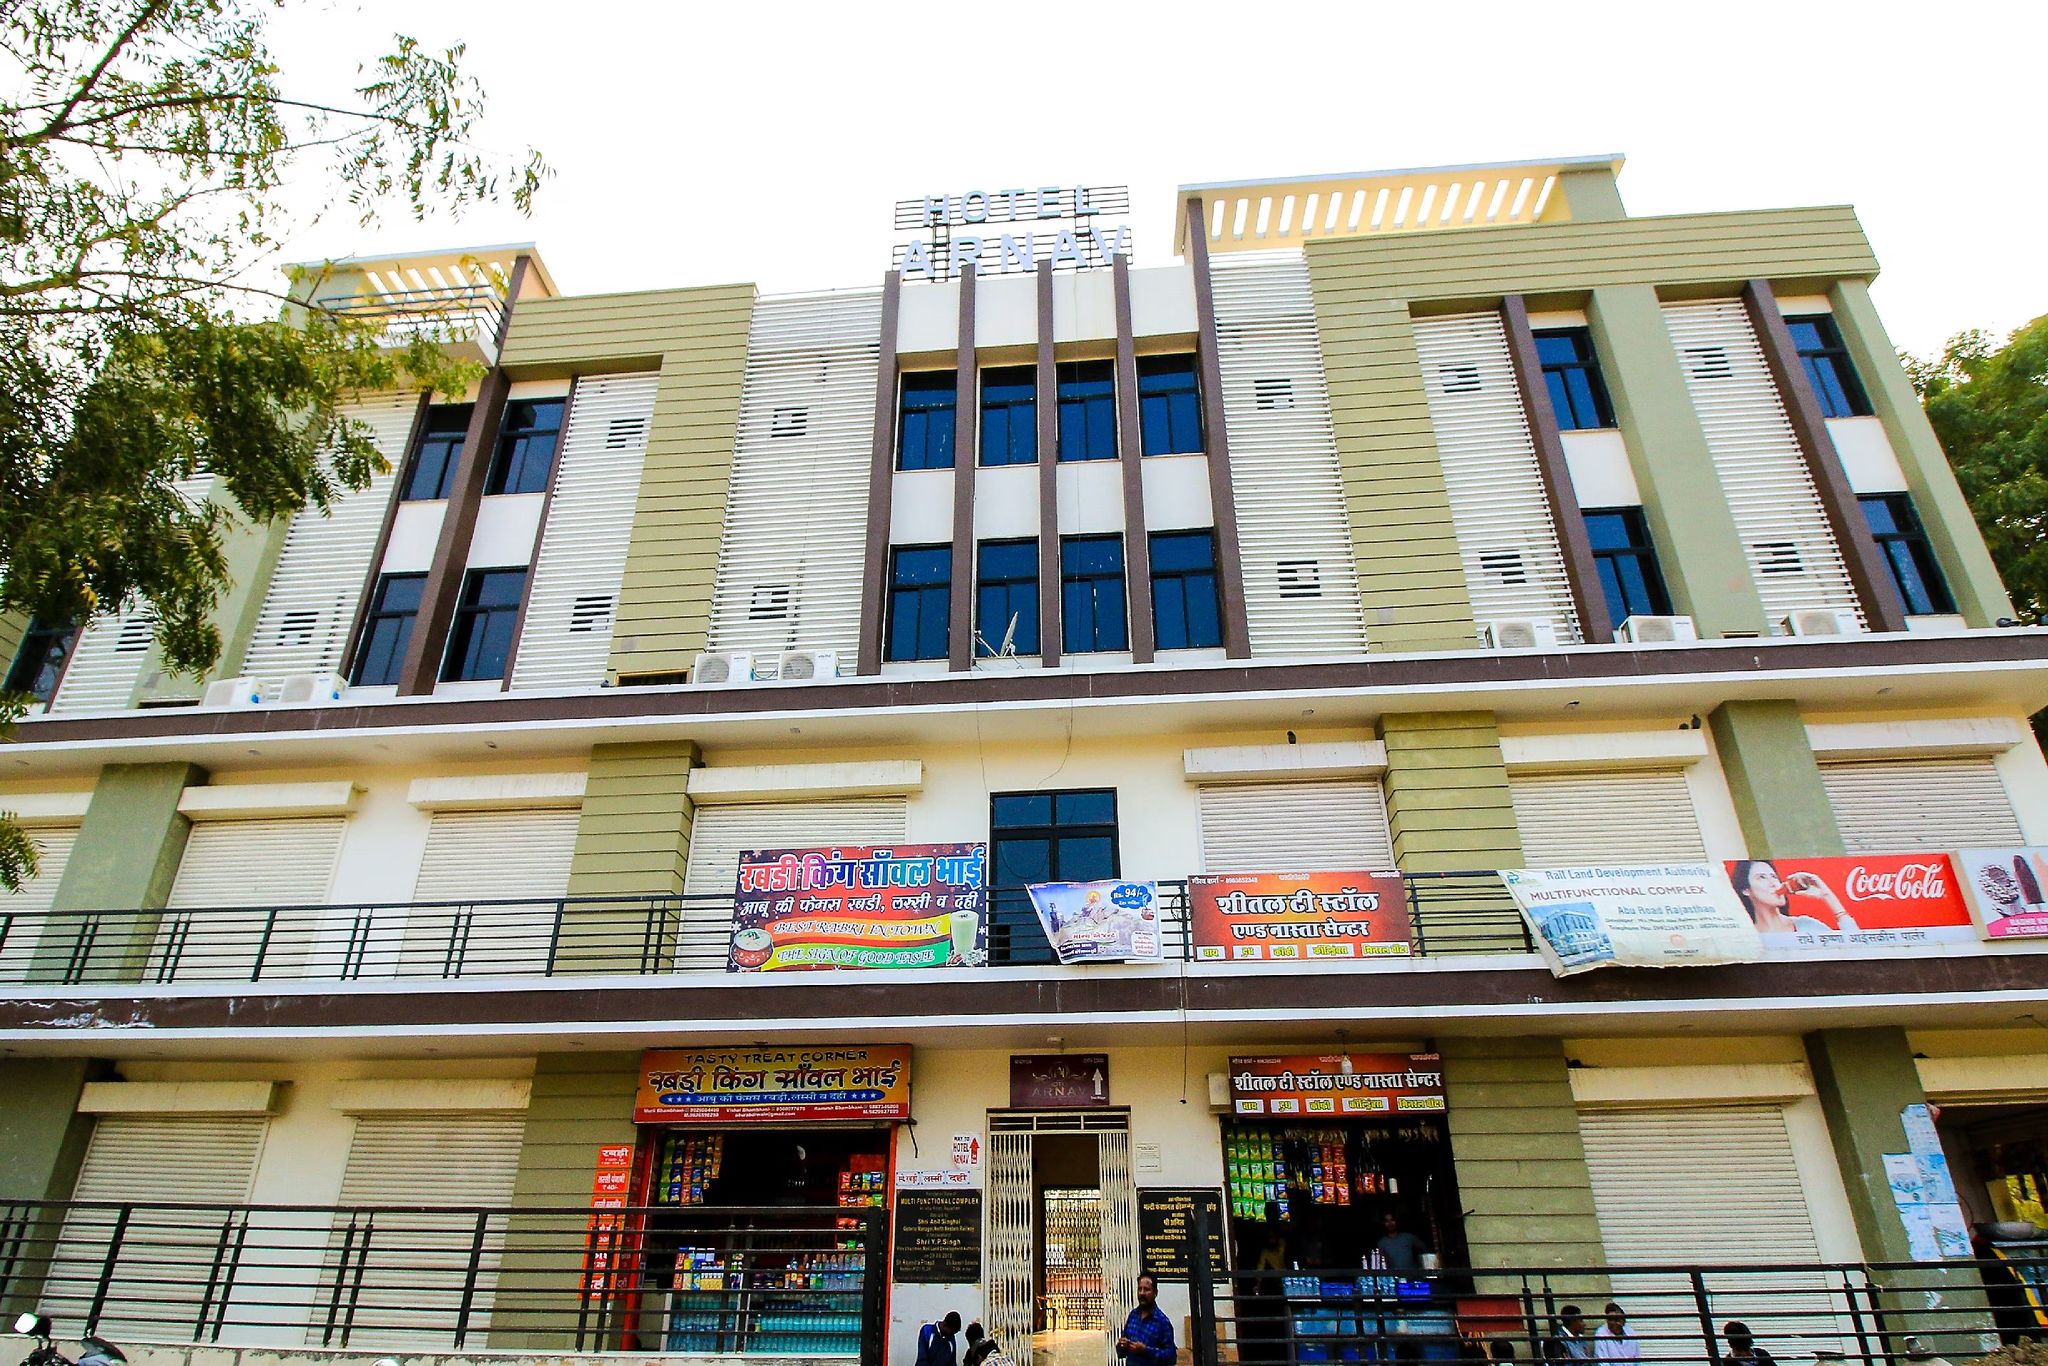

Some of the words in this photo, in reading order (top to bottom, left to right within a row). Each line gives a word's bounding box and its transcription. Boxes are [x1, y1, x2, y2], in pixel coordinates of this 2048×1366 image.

[922, 185, 1100, 227] HOTEL
[899, 225, 1127, 278] ARNAV
[801, 850, 858, 891] किंग
[936, 847, 985, 890] भाई
[1545, 870, 1566, 880] Rail
[1569, 869, 1593, 879] Land
[1597, 867, 1662, 879] Development
[1665, 866, 1711, 878] Authority
[1529, 886, 1645, 901] MULTIFUNCTIONAL
[1648, 885, 1707, 896] COMPLEX
[1845, 863, 1947, 902] Coca-Cola
[775, 896, 795, 913] की
[1216, 890, 1286, 915] शीतल
[1288, 889, 1317, 914] टी
[1319, 887, 1379, 913] स्टॉल
[774, 920, 816, 935] BEST
[817, 920, 864, 937] RABRI
[685, 1053, 738, 1064] TASTY
[743, 1051, 796, 1064] TREAT
[800, 1049, 869, 1063] CORNER
[712, 1065, 769, 1091] किंग
[852, 1060, 900, 1088] भाई
[1233, 1072, 1277, 1091] शीतल
[1278, 1071, 1295, 1090] टी
[1296, 1069, 1333, 1090] स्टॉल
[953, 1142, 970, 1153] HOTEL
